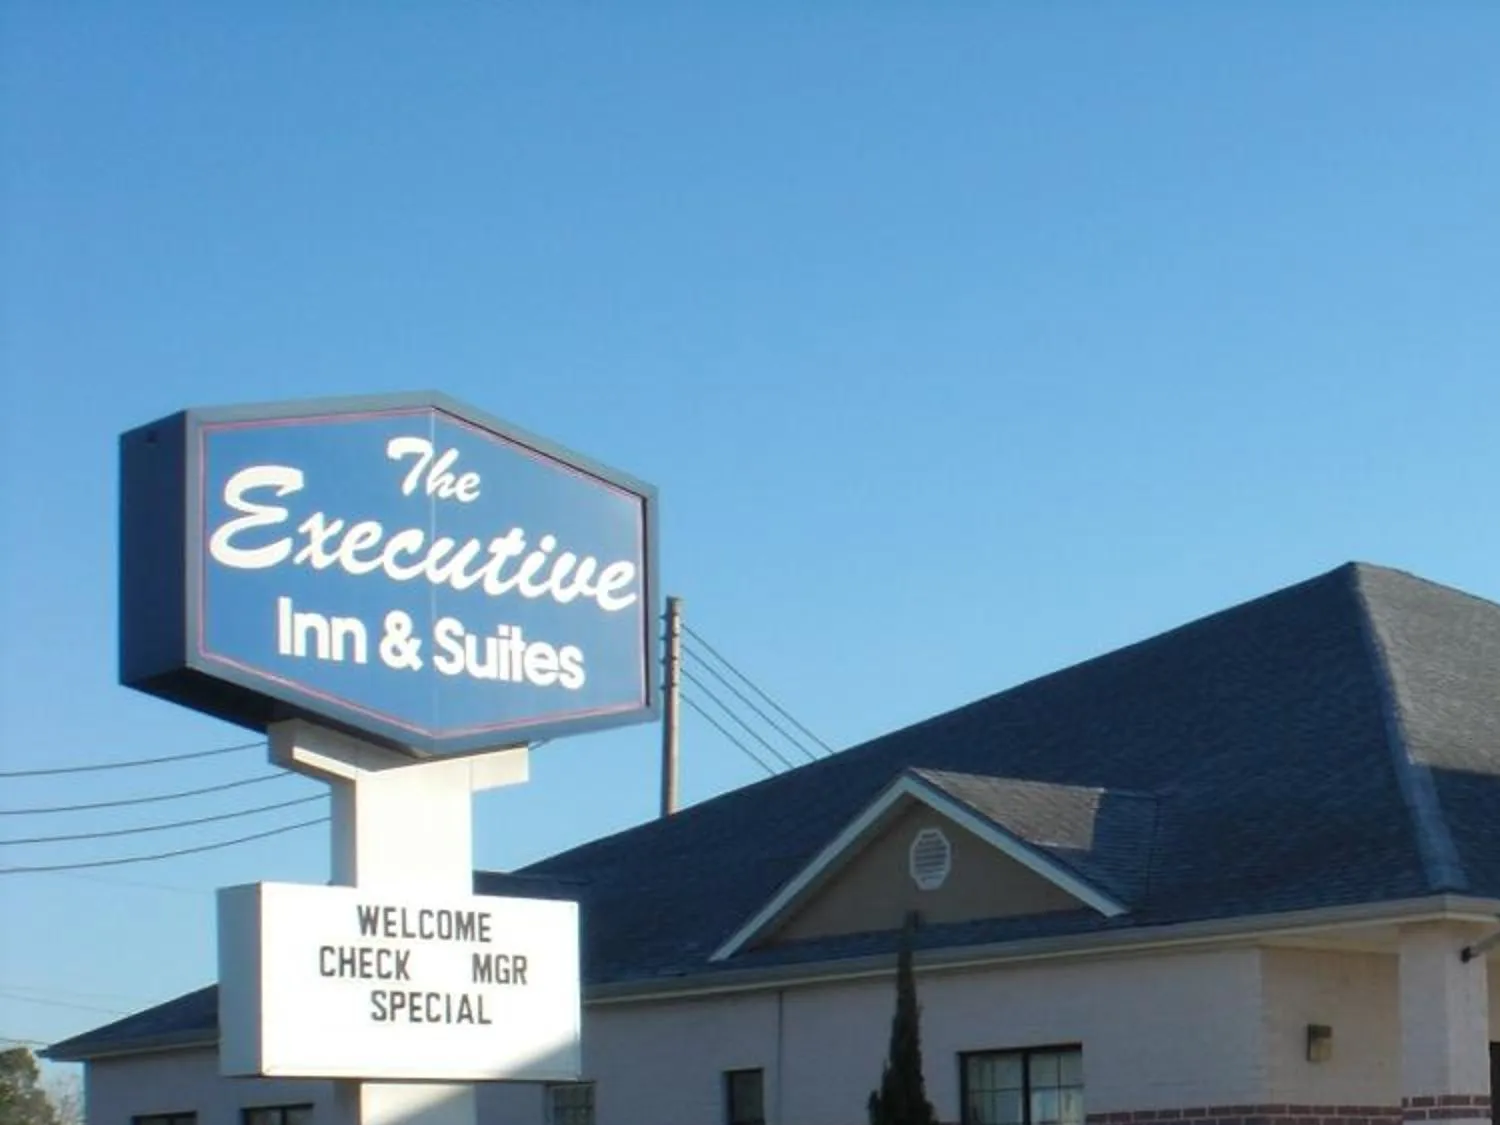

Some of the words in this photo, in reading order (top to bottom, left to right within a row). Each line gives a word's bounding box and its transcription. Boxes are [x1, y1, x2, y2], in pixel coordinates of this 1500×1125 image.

[386, 437, 481, 502] The
[209, 465, 637, 612] Executive
[278, 596, 367, 664] Inn
[380, 610, 423, 672] &
[433, 616, 586, 690] Suites
[356, 904, 492, 943] WELCOME
[319, 946, 411, 981] CHECK
[472, 953, 528, 985] MGR
[370, 990, 492, 1025] SPECIAL
